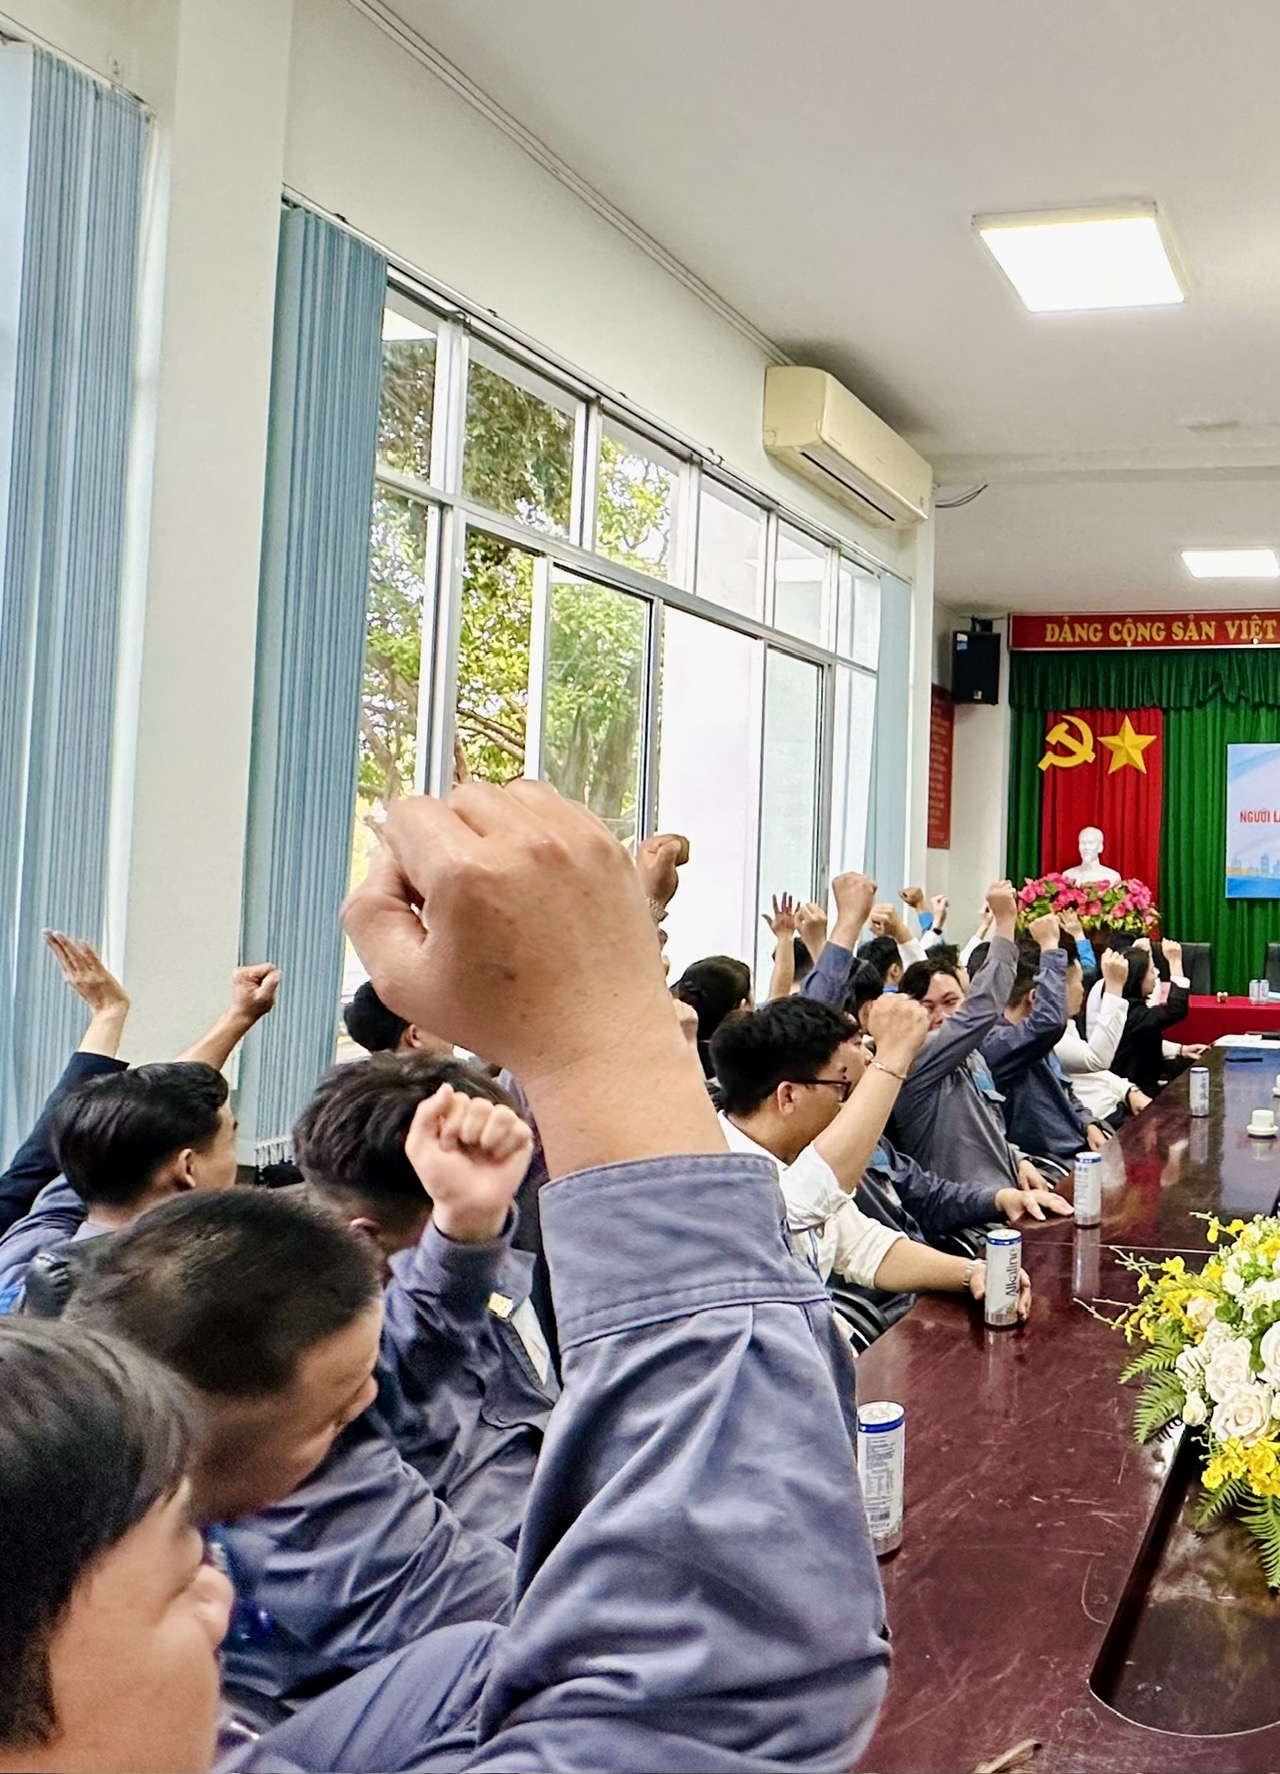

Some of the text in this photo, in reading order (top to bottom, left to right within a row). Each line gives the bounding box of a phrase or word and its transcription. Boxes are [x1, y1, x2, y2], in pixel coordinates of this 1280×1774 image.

[1045, 615, 1103, 643] ĐẢNG
[1108, 617, 1166, 648] CỘNG
[1171, 614, 1217, 641] SẢN
[1225, 614, 1278, 645] VIỆT
[1240, 808, 1271, 823] NGƯỜI
[1006, 1248, 1019, 1297] Alkaline
